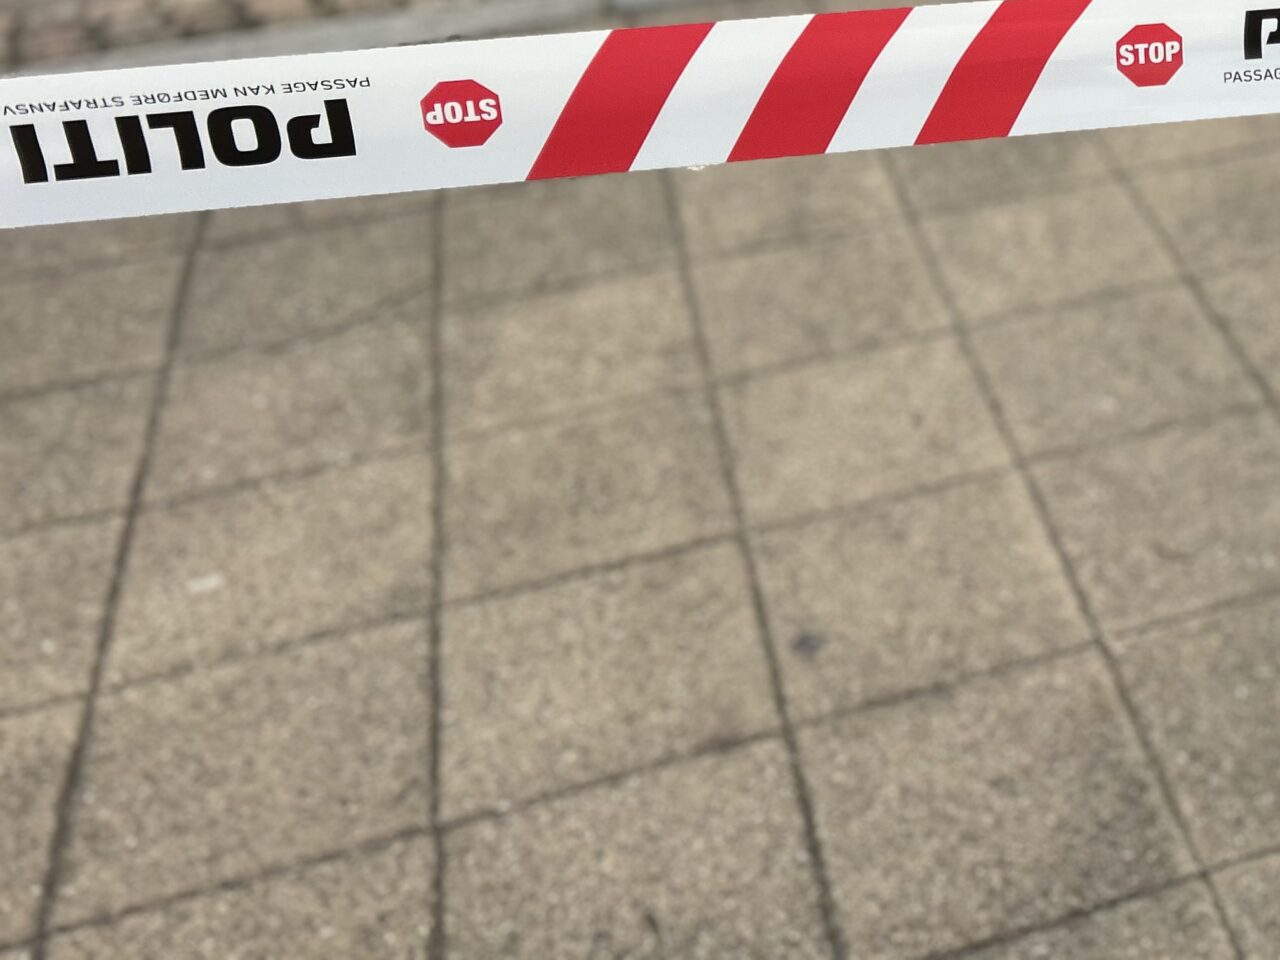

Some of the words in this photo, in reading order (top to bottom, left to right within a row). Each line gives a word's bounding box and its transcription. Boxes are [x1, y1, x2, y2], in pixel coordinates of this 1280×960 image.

[1119, 40, 1181, 67] STOP
[234, 84, 276, 98] KAN
[280, 77, 371, 94] PASSAGE
[129, 88, 228, 107] MEDFØRE
[425, 98, 499, 125] STOP
[9, 97, 357, 184] POLITI
